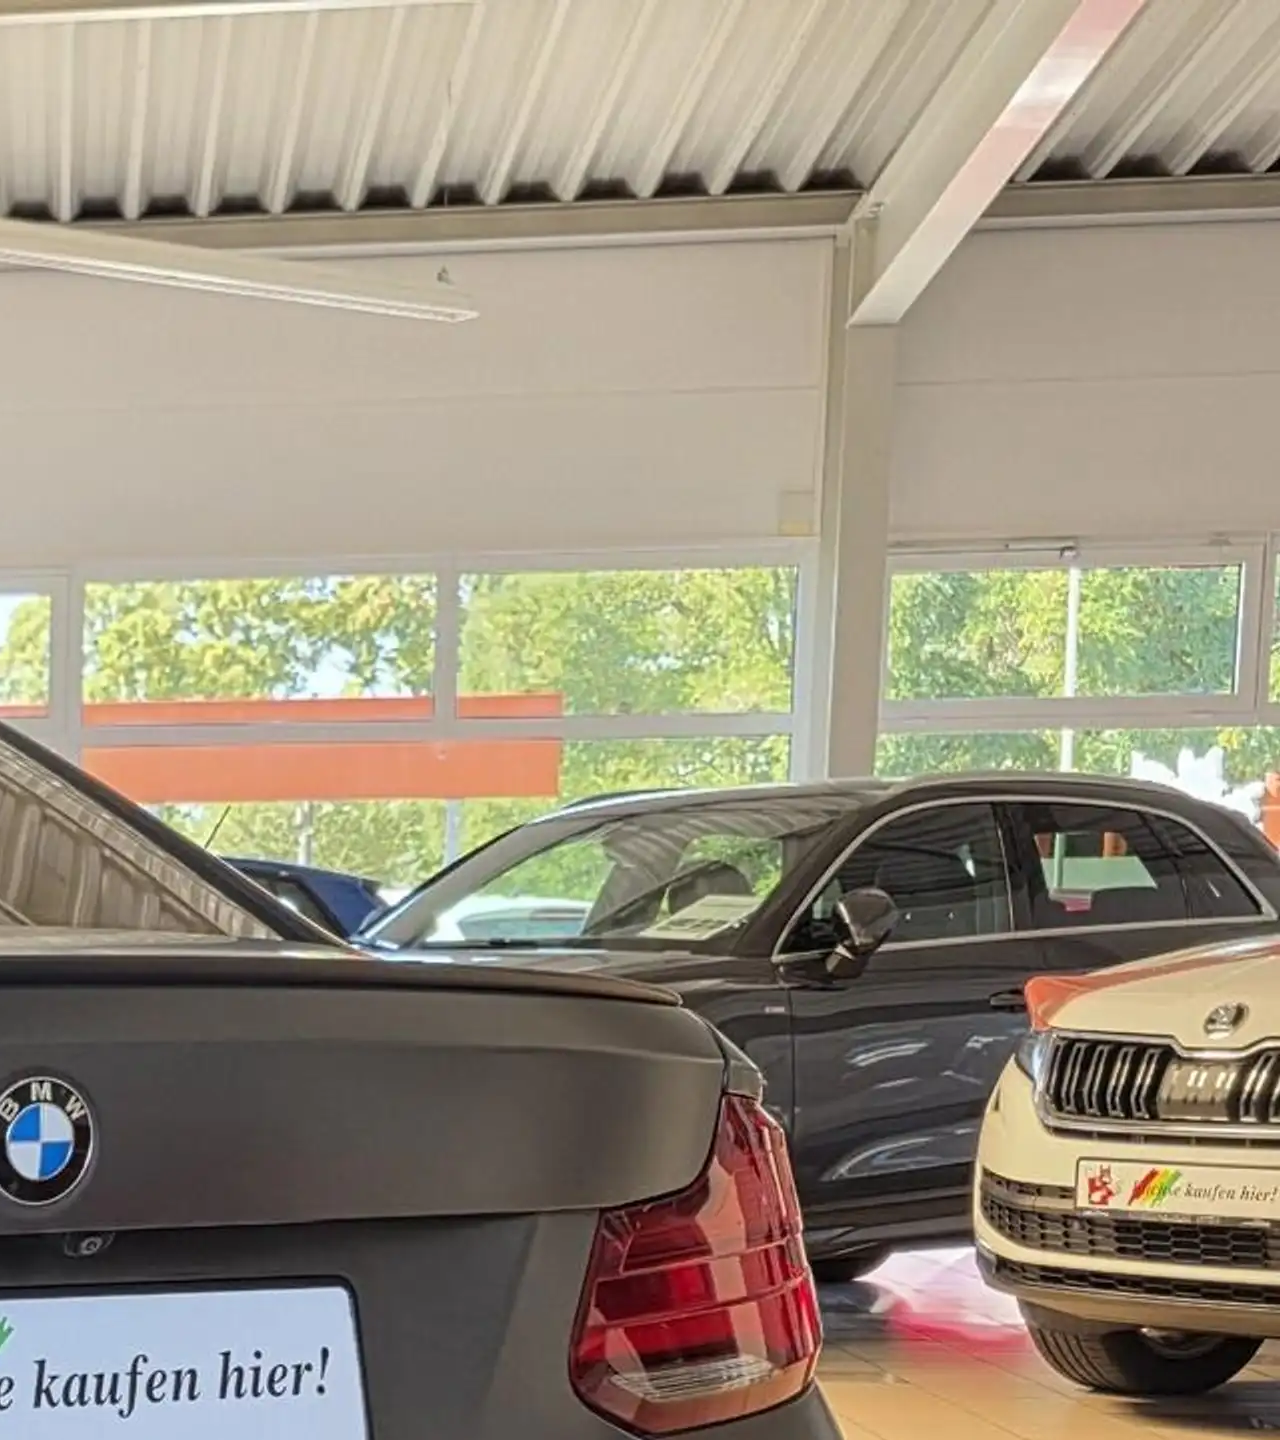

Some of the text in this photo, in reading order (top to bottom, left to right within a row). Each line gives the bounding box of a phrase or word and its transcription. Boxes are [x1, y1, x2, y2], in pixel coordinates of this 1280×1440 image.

[1184, 1183, 1236, 1201] kaufen
[1240, 1184, 1279, 1202] hier!
[33, 1354, 200, 1419] kaufen
[219, 1346, 330, 1400] hier!
